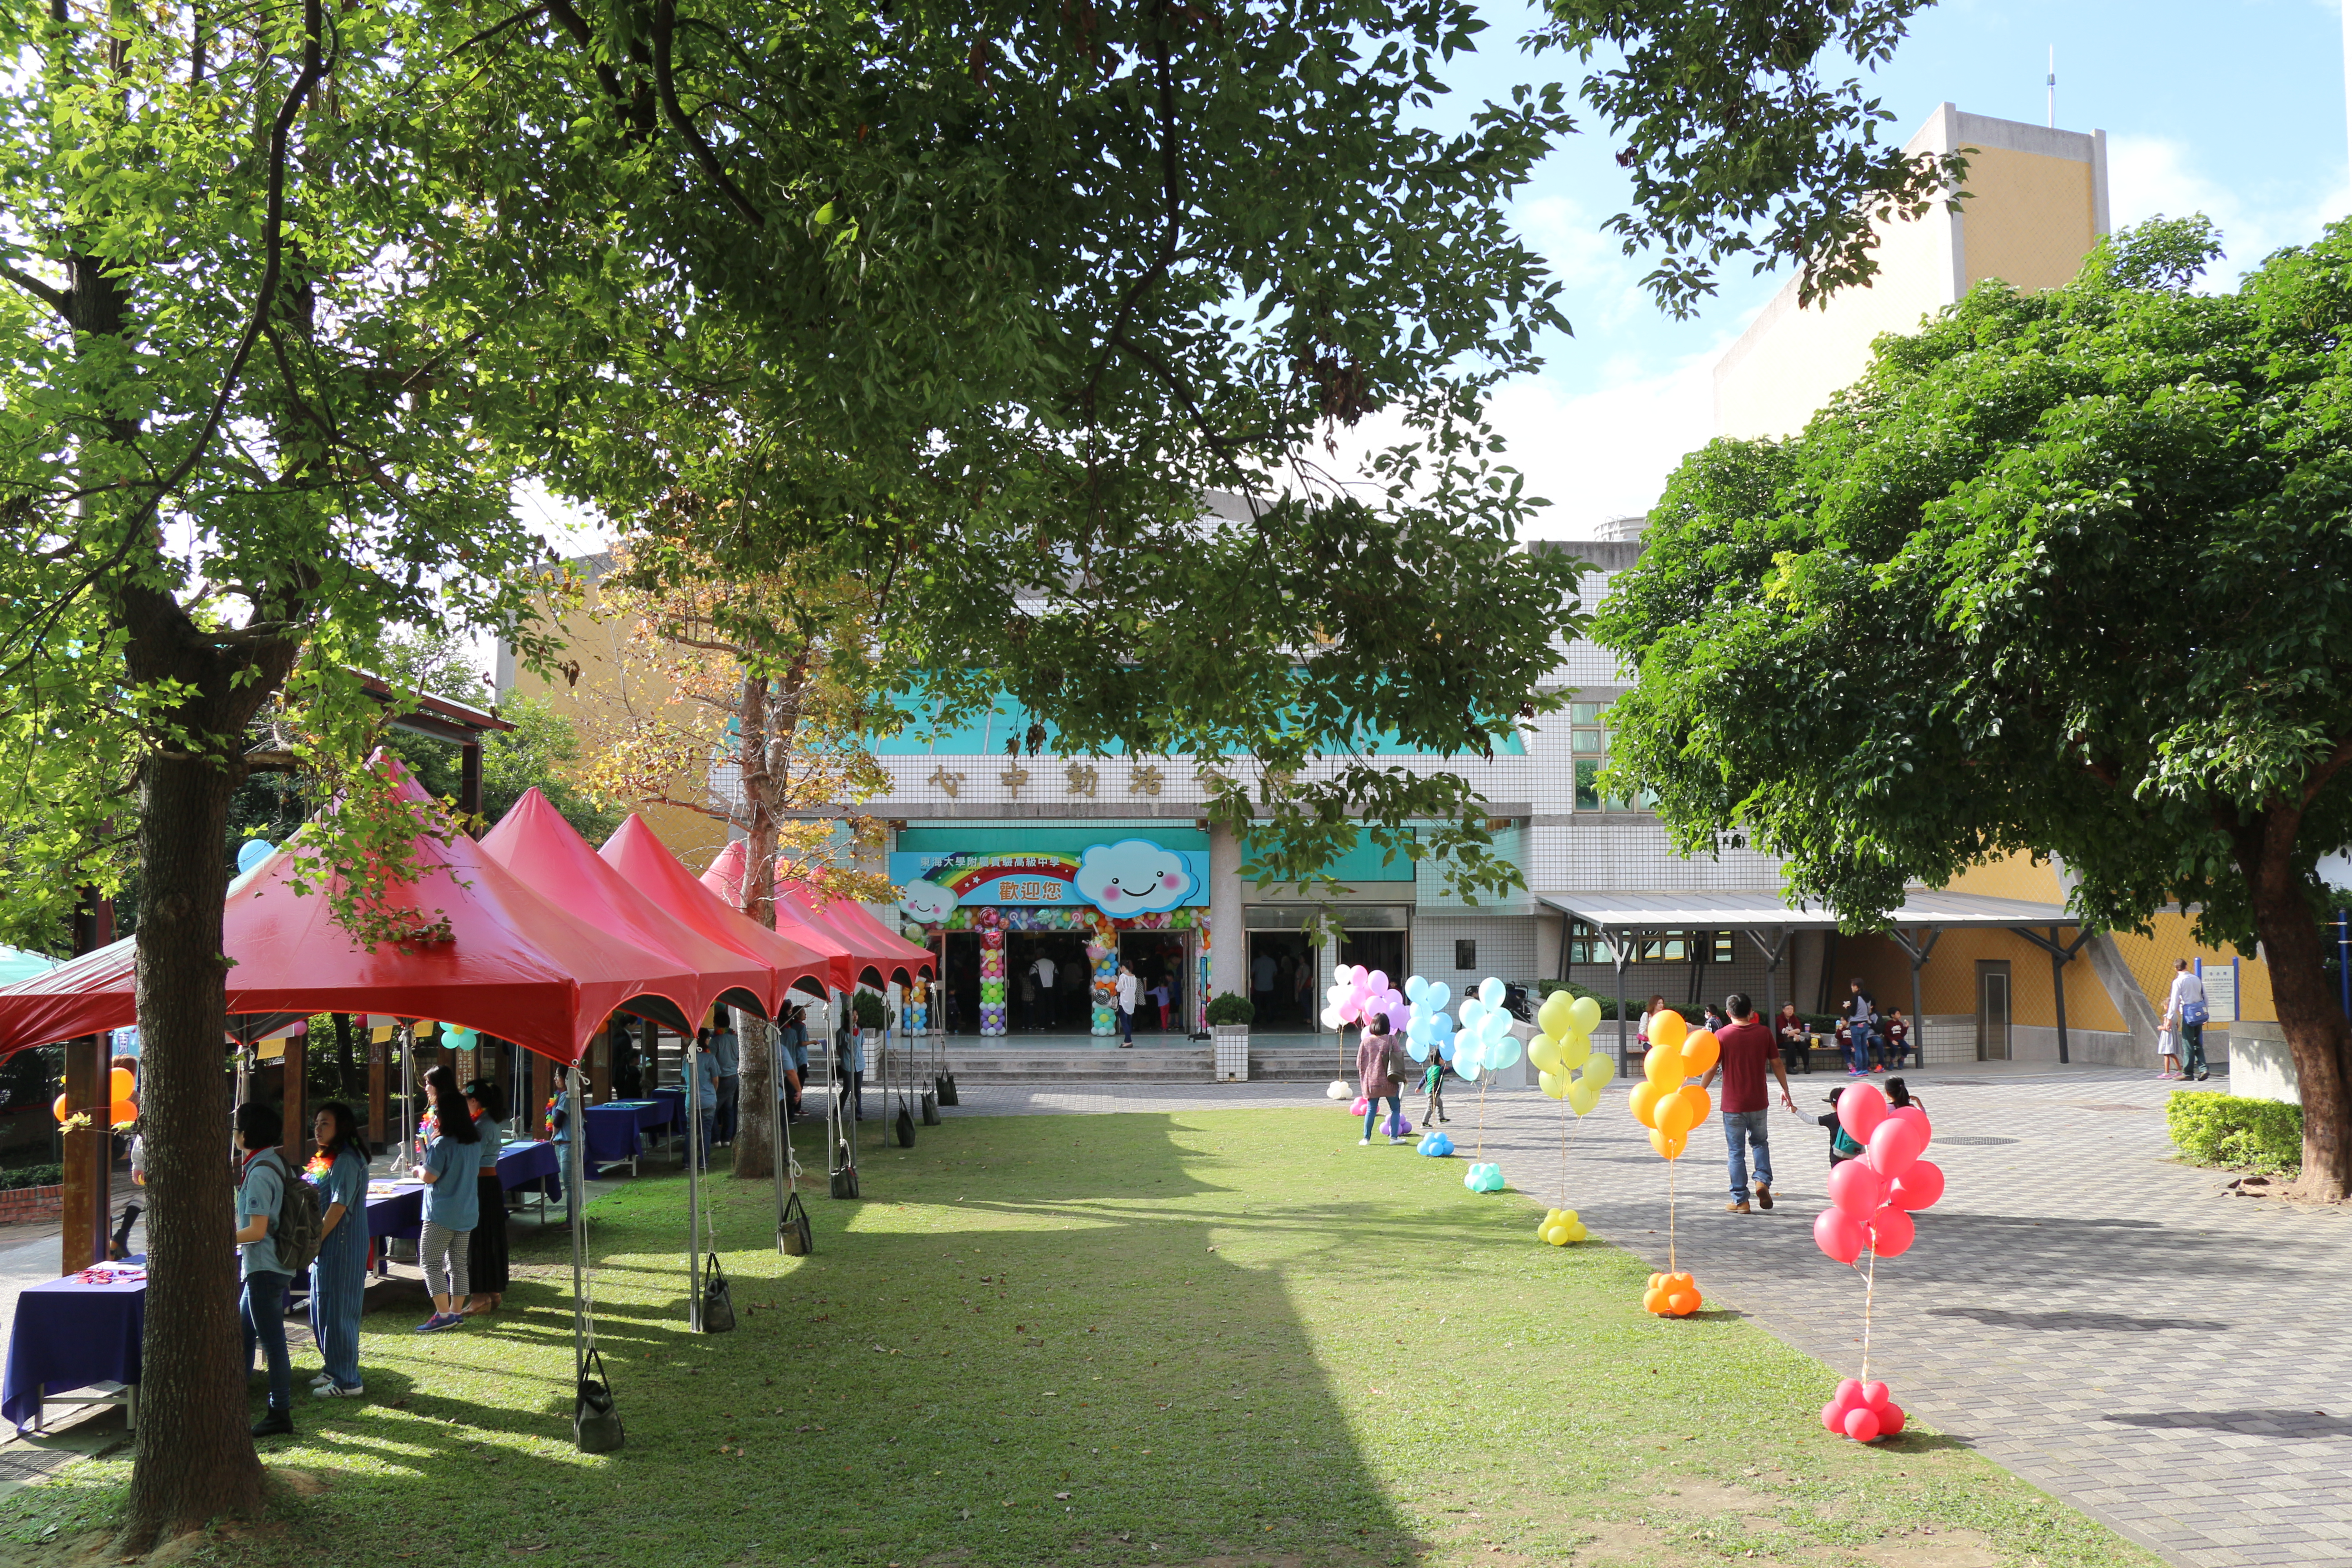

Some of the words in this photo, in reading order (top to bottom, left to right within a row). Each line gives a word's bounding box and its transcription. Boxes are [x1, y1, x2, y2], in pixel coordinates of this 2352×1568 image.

[920, 857, 1060, 867] 東海大學附屬實驗高級中學
[999, 881, 1062, 901] 歡迎您
